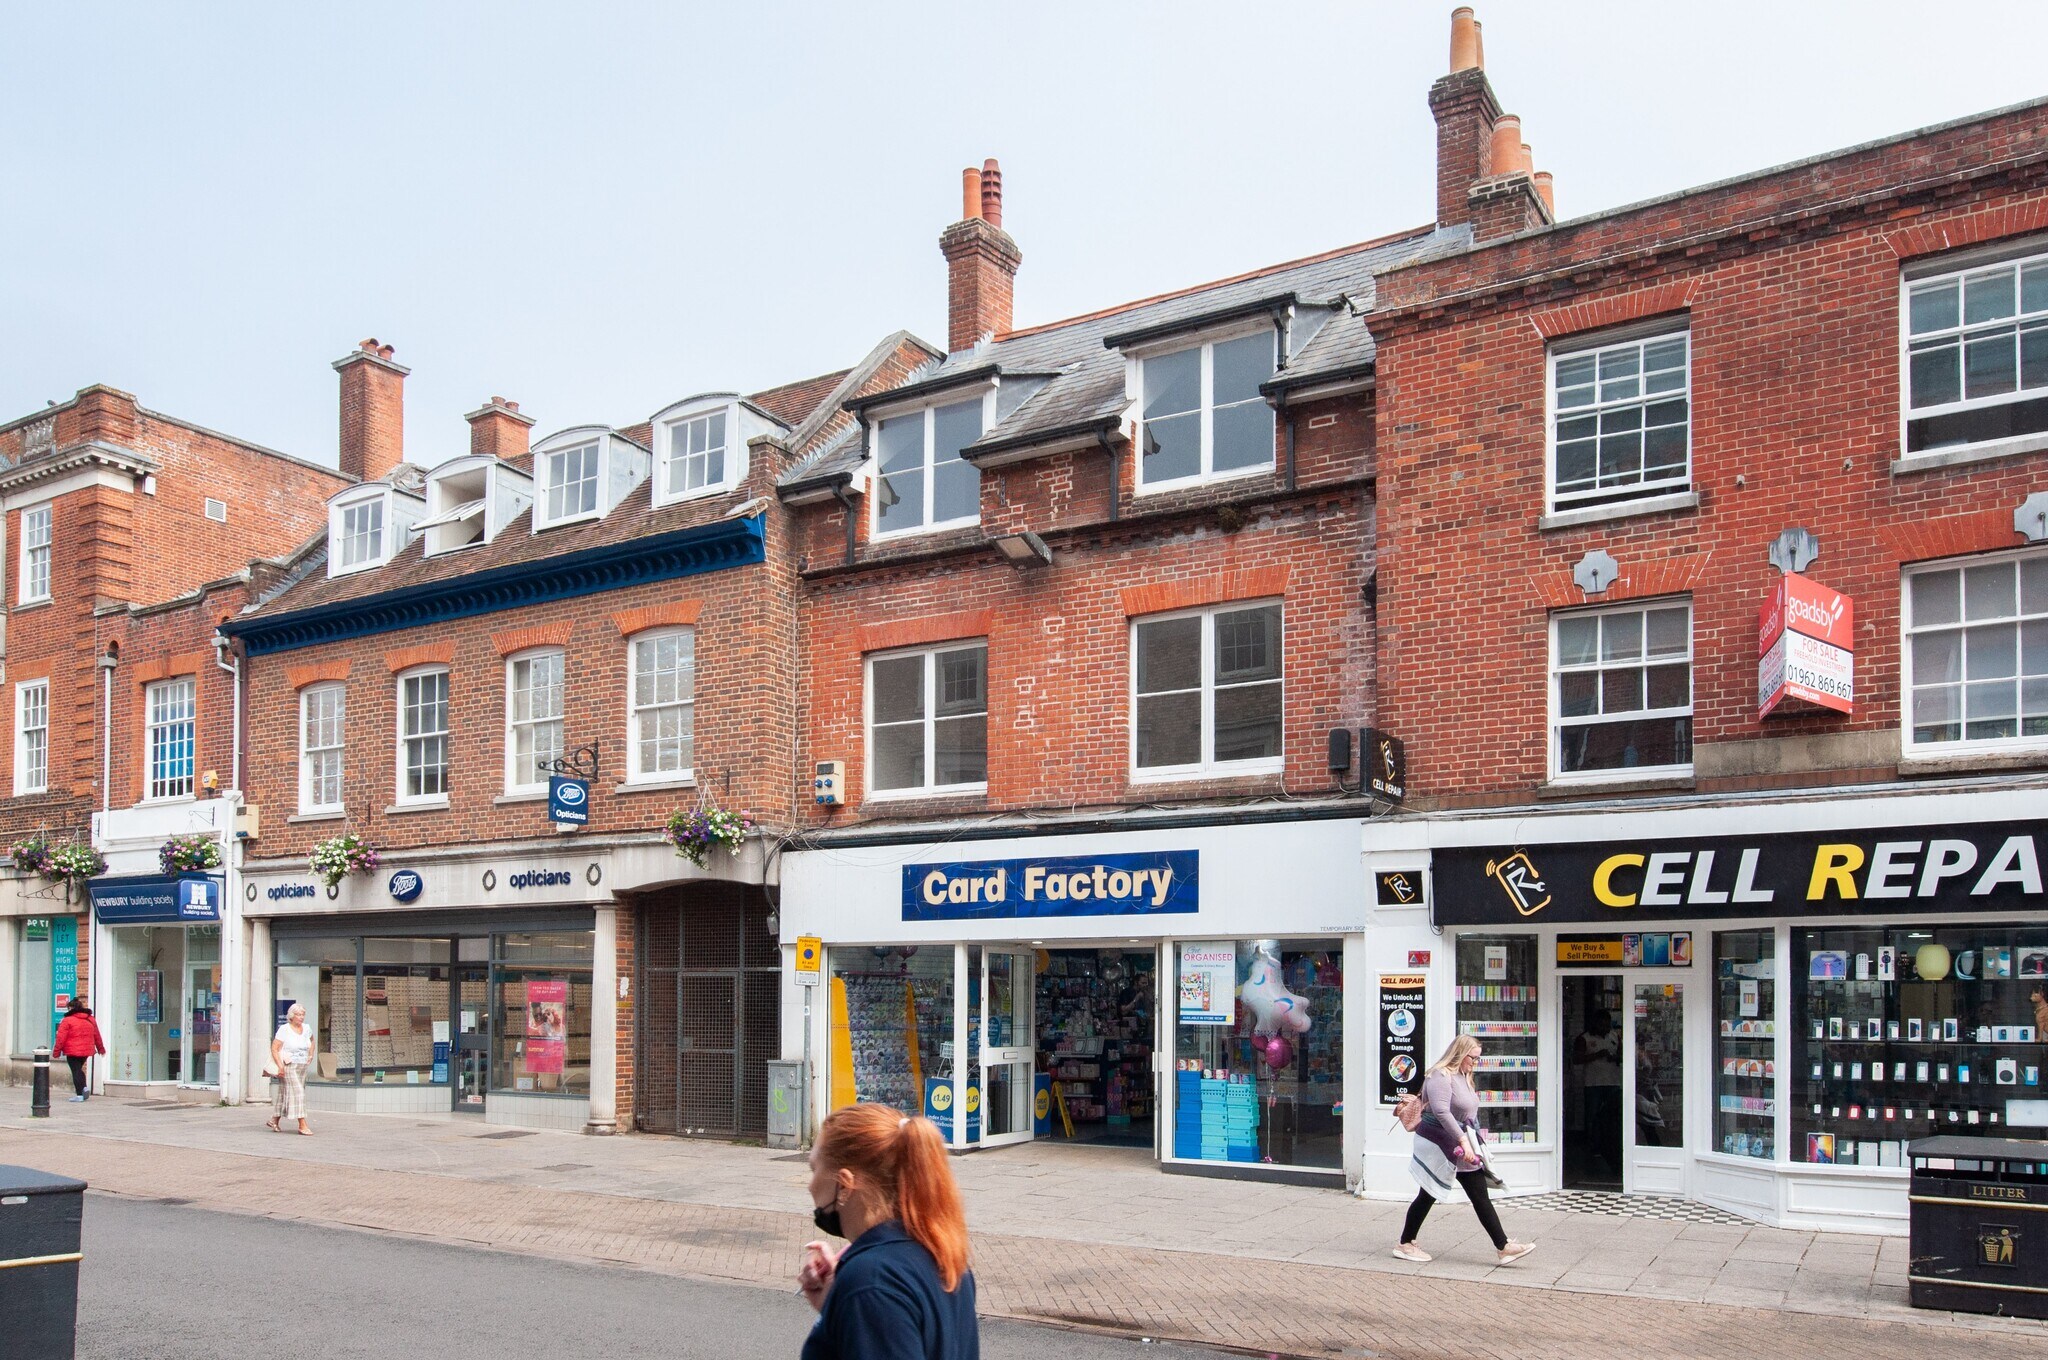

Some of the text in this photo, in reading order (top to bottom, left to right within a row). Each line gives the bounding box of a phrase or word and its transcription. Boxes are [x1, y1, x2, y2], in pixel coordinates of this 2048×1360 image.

[1788, 596, 1835, 638] goadsby
[1803, 638, 1839, 662] FOR SALE
[1794, 649, 1818, 665] FREEHOLD
[1818, 656, 1847, 674] INVESTMENT
[1788, 664, 1816, 688] 01962
[1818, 675, 1835, 694] 869
[1837, 681, 1852, 699] 667
[1372, 778, 1385, 792] CELL
[556, 809, 587, 821] Opticians
[1592, 835, 2044, 908] CELL REPA
[391, 875, 417, 895] Boots
[510, 869, 571, 890] opticians
[923, 864, 1172, 907] Card Factory
[268, 883, 316, 901] opticians
[96, 894, 174, 907] NEWBURY building society
[56, 923, 67, 933] TO
[56, 934, 70, 943] LET
[55, 947, 74, 955] PRIME
[1584, 944, 1597, 952] Buy
[55, 956, 71, 964] HIGH
[1183, 953, 1233, 962] ORGANISED
[1567, 952, 1609, 960] Sell Phones
[55, 964, 77, 973] STREET
[55, 973, 75, 981] CLASS
[55, 982, 70, 991] UNIT
[1391, 1044, 1414, 1052] Damage
[933, 1094, 951, 1103] £1.49
[1384, 1095, 1403, 1103] Replac
[1972, 1185, 2027, 1199] LITTER
